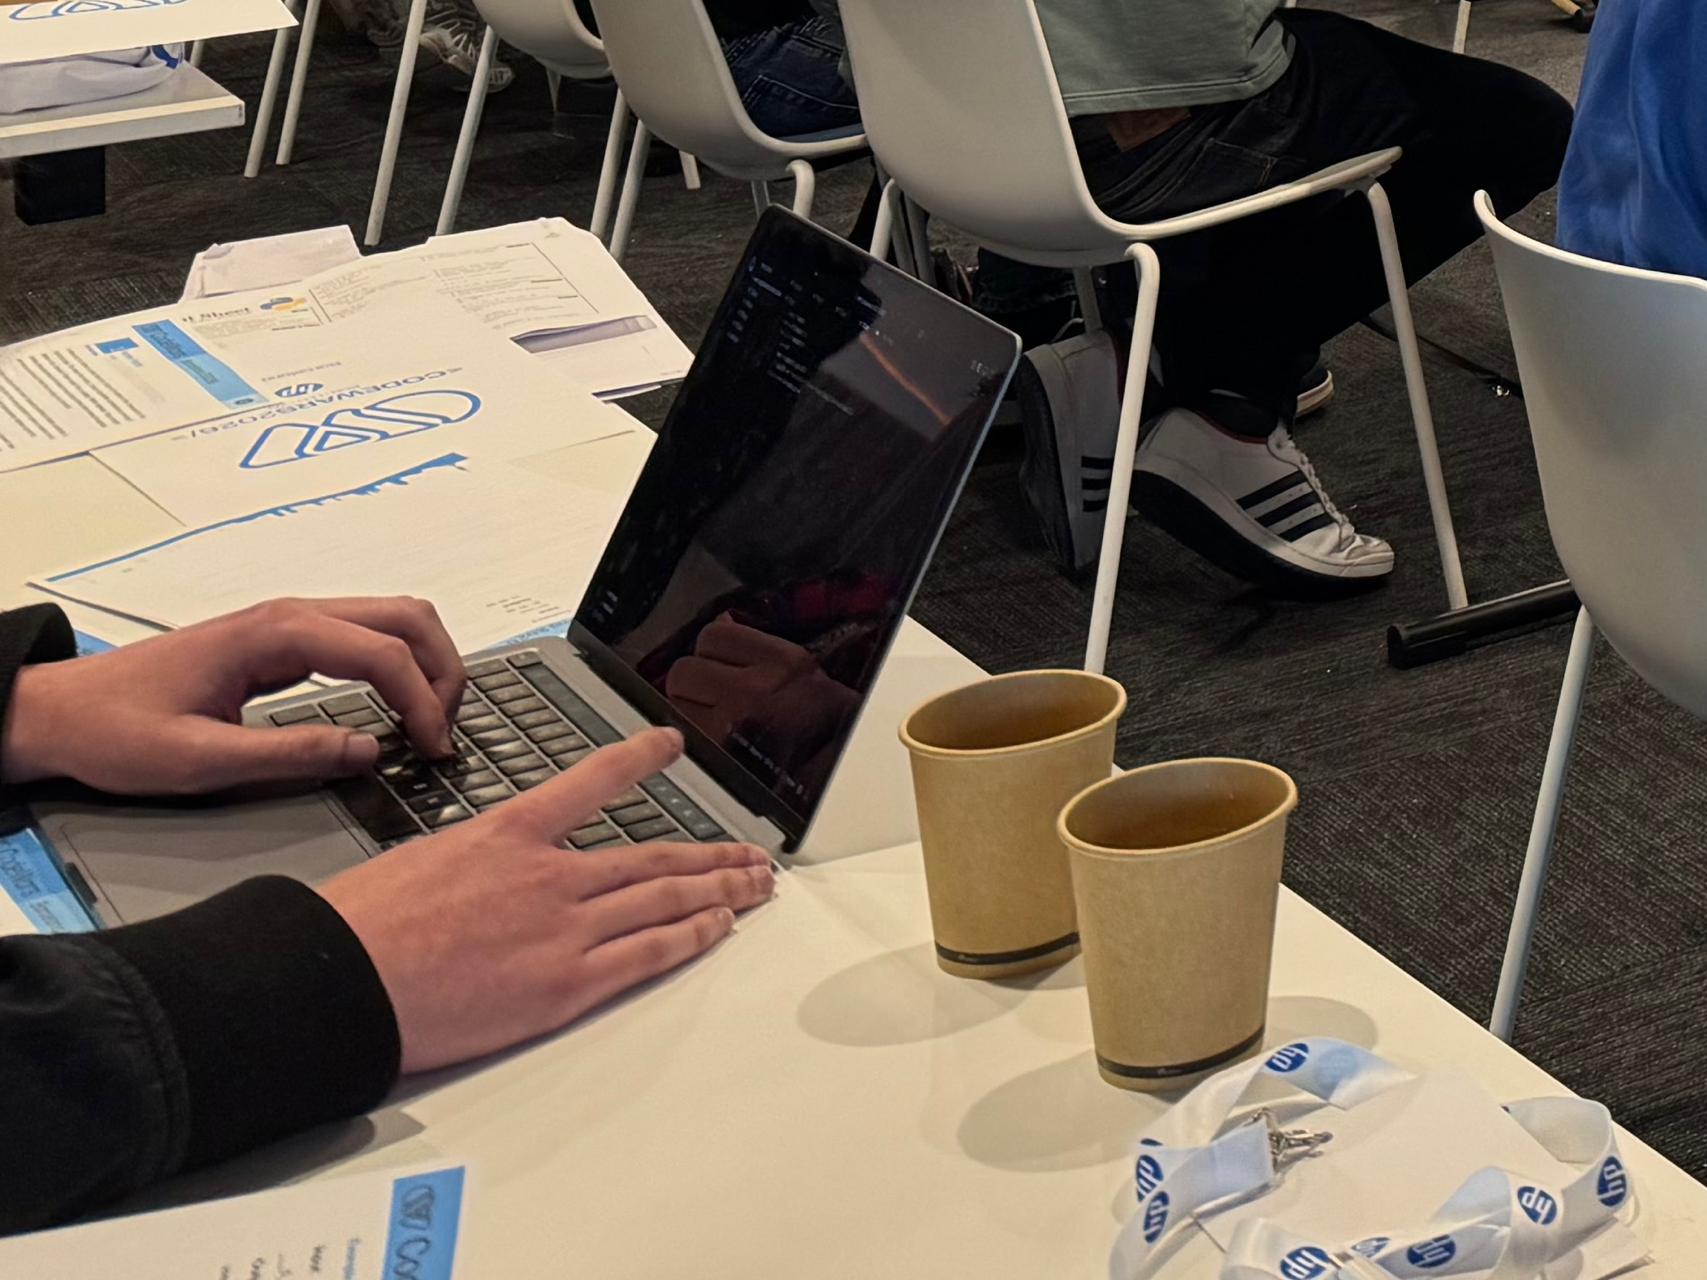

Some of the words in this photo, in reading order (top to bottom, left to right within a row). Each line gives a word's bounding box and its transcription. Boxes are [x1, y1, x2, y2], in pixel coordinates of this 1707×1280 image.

[1597, 1155, 1628, 1207] hp
[1517, 1185, 1558, 1226] hp
[1407, 1234, 1457, 1269] hp
